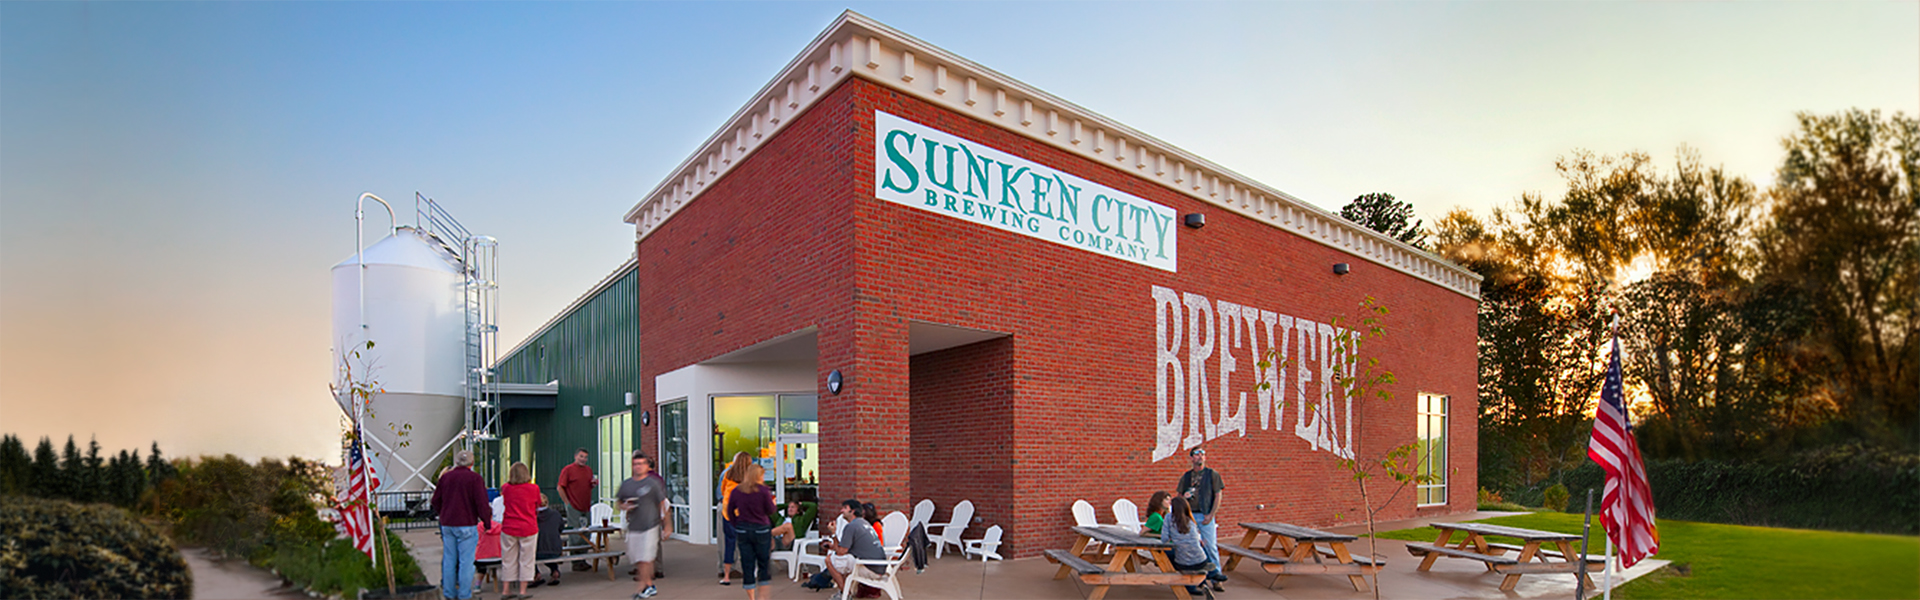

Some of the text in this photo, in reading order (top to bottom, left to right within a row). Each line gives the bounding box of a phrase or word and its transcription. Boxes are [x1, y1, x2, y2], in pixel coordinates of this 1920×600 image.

[882, 129, 1173, 260] SUNKEN CITY
[924, 188, 1150, 262] BREWING COMPANY
[1151, 284, 1361, 463] BREWERY
